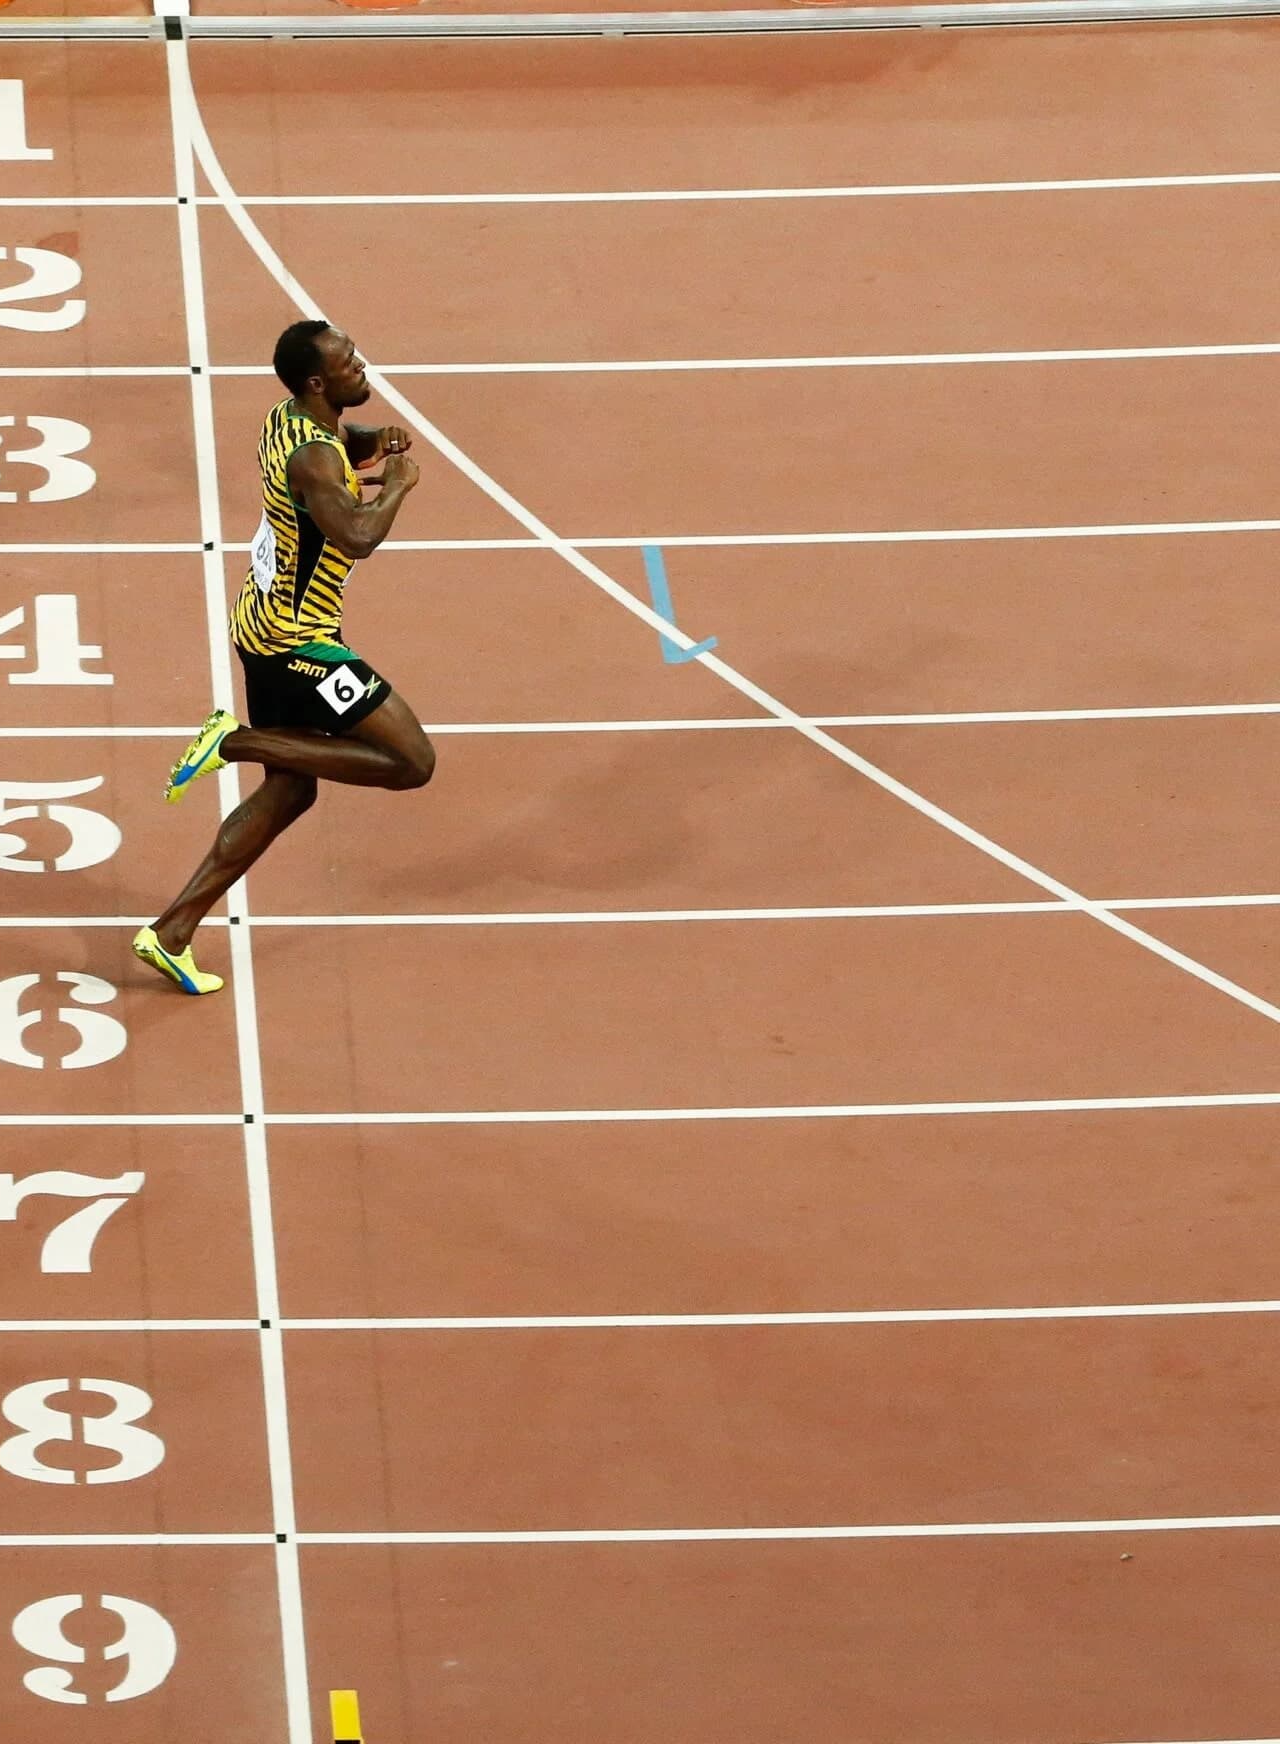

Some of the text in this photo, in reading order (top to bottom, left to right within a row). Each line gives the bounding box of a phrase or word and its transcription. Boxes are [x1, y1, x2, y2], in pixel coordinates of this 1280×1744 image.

[287, 659, 328, 679] JAM
[334, 678, 355, 703] 6
[11, 1594, 177, 1705] 9
